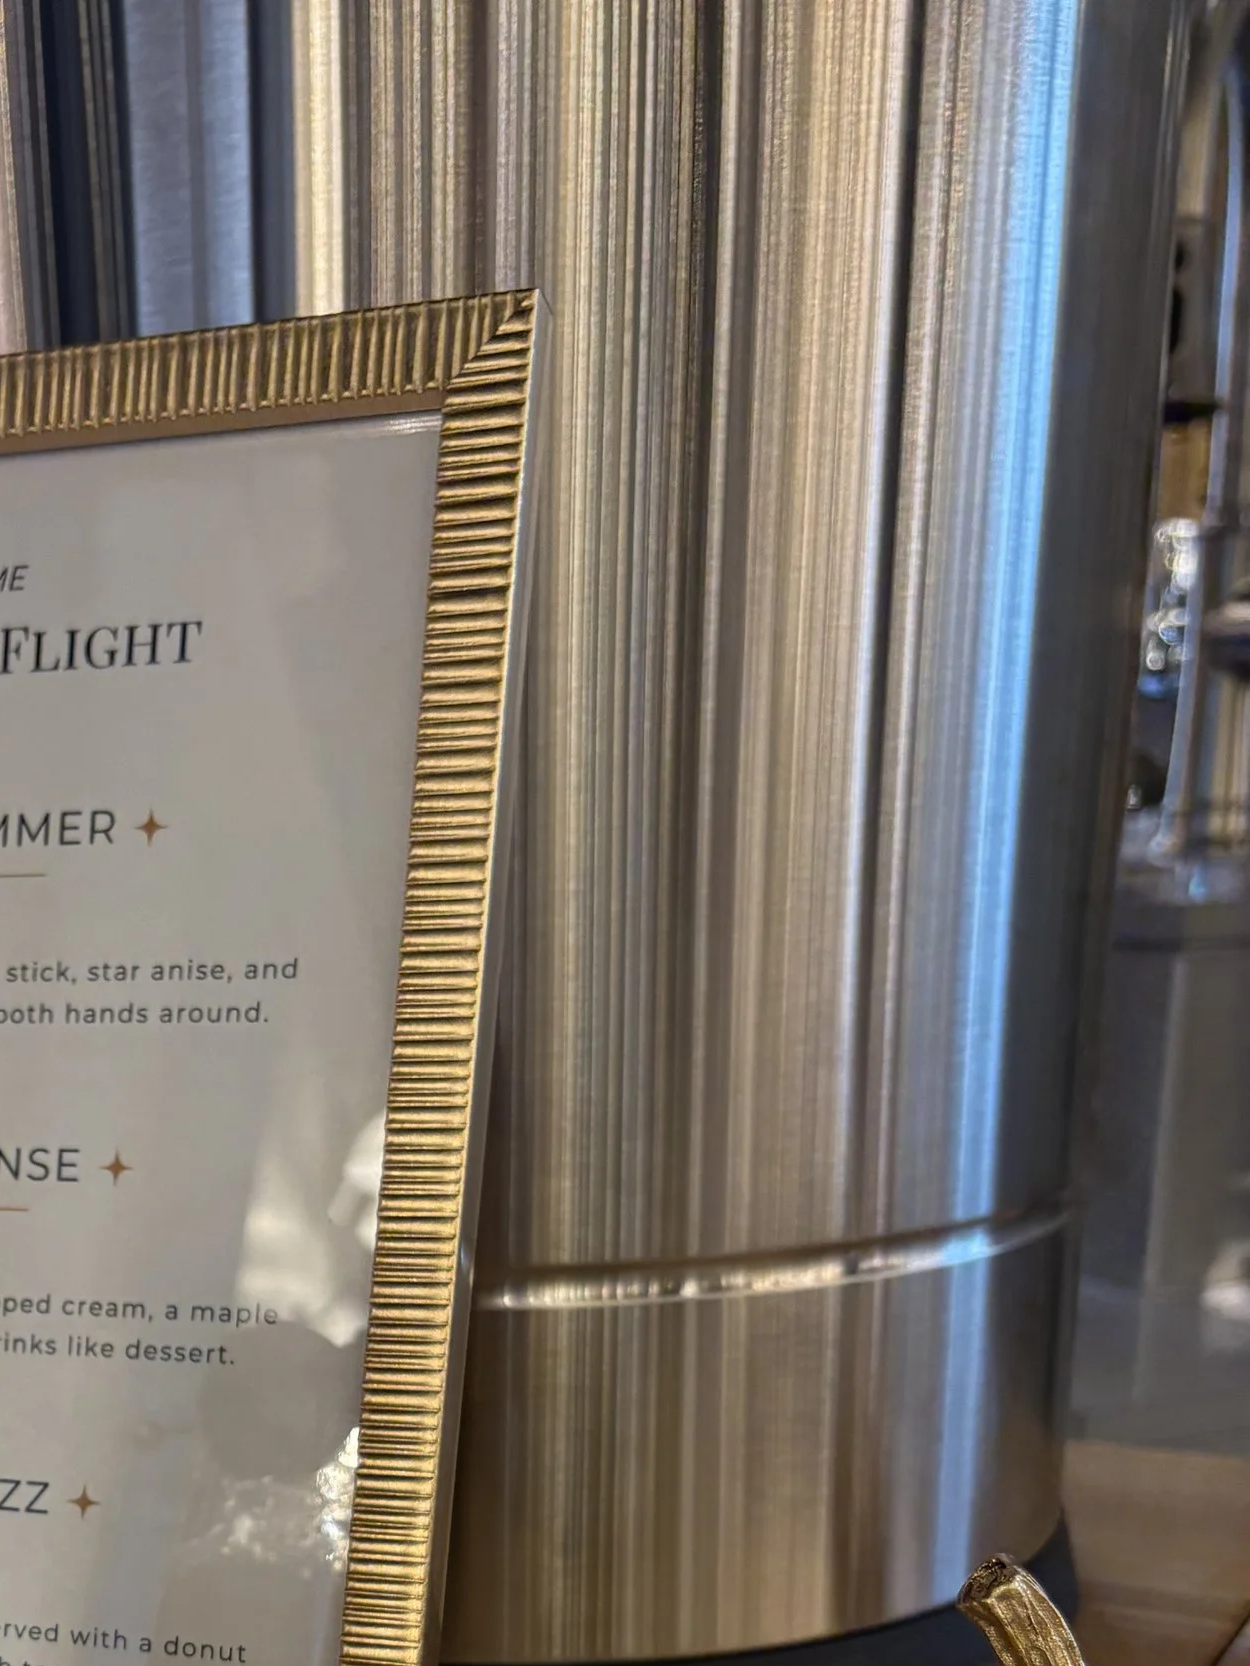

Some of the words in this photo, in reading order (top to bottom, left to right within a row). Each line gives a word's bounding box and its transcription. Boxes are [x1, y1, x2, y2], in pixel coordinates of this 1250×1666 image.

[6, 961, 77, 985] stick,
[87, 961, 140, 983] star
[151, 959, 233, 983] anise,
[244, 957, 298, 980] and
[65, 1003, 148, 1025] hands
[159, 1001, 269, 1024] around.
[61, 1298, 154, 1323] cream,
[165, 1304, 178, 1321] a
[190, 1302, 278, 1329] maple
[68, 1335, 115, 1359] like
[125, 1339, 235, 1366] dessert.
[70, 1626, 128, 1650] with
[139, 1637, 152, 1654] a
[163, 1637, 247, 1664] donut
